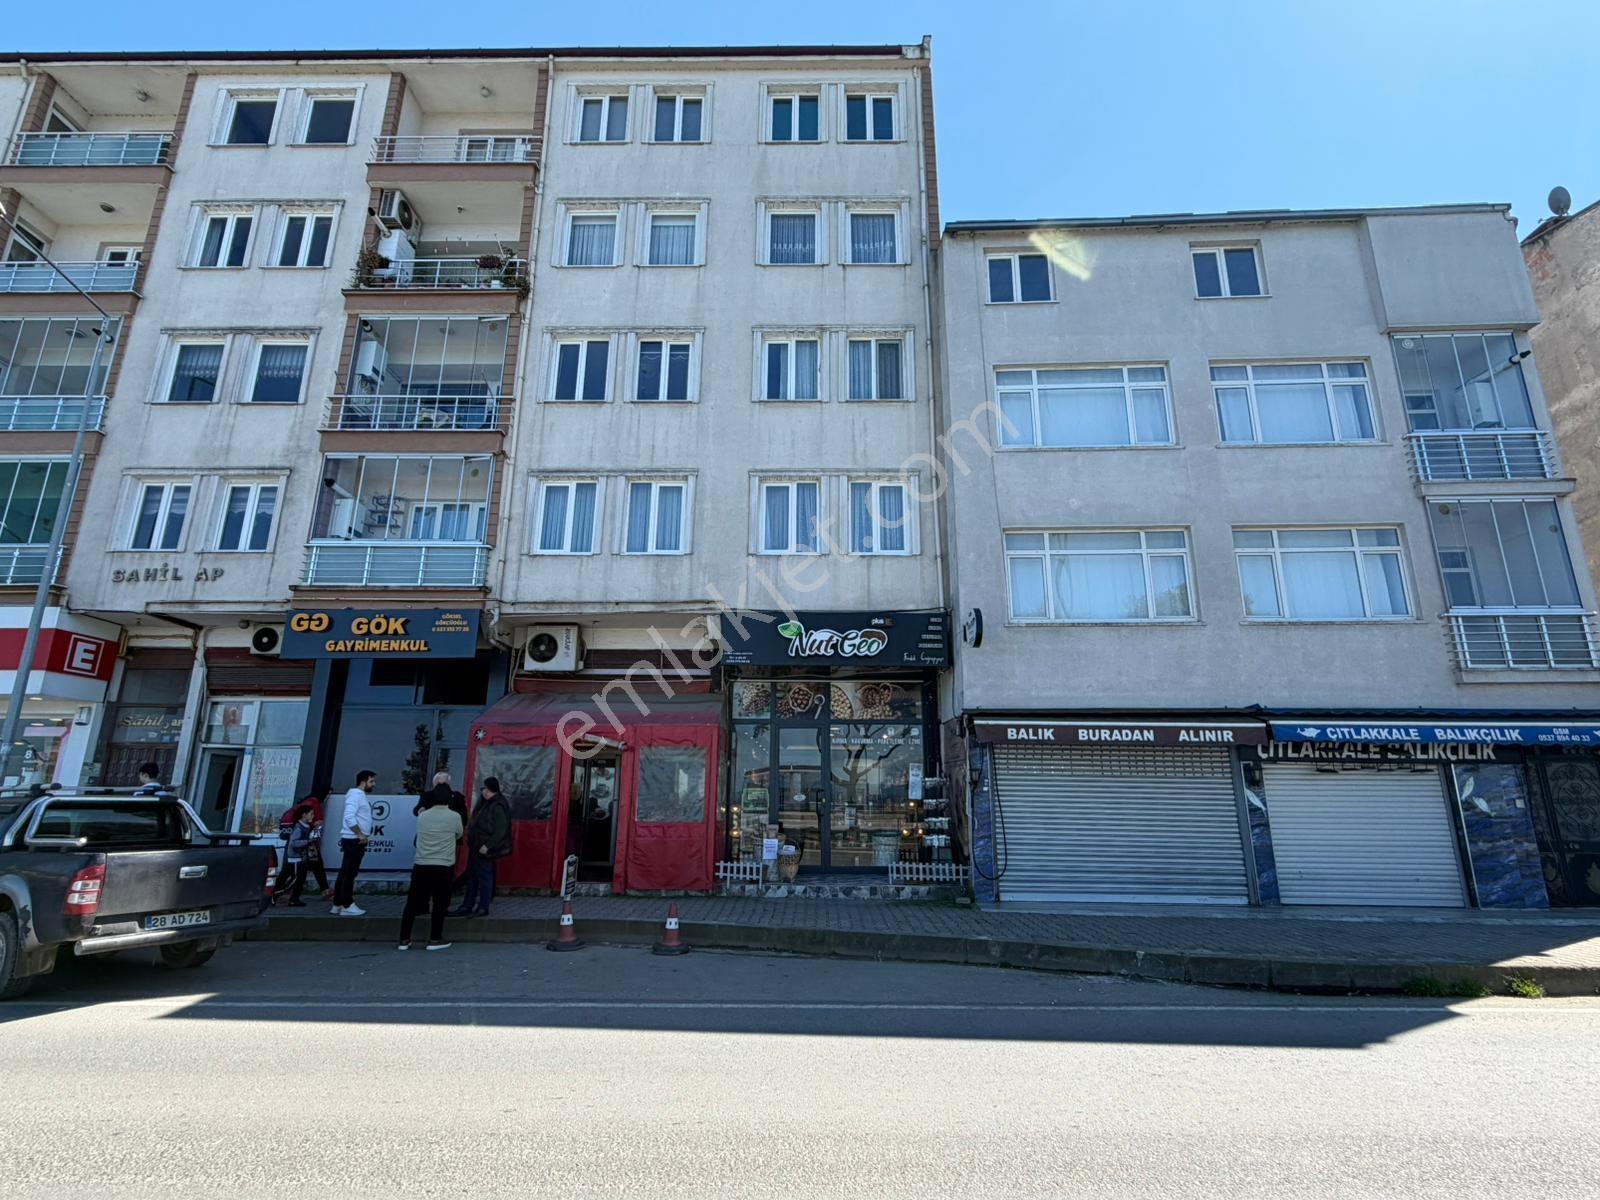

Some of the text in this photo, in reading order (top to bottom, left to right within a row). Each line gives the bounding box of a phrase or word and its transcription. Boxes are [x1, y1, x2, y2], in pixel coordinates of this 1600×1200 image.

[112, 562, 225, 583] SAHİL AP
[351, 614, 408, 635] GÖK
[325, 638, 429, 652] GAYRİMENKUL
[788, 630, 884, 657] Nut Geo
[1007, 728, 1235, 743] BALIK BURADAN ALINIR
[1434, 728, 1524, 743] BALIKÇILIK
[152, 912, 208, 928] 28 AD 724
